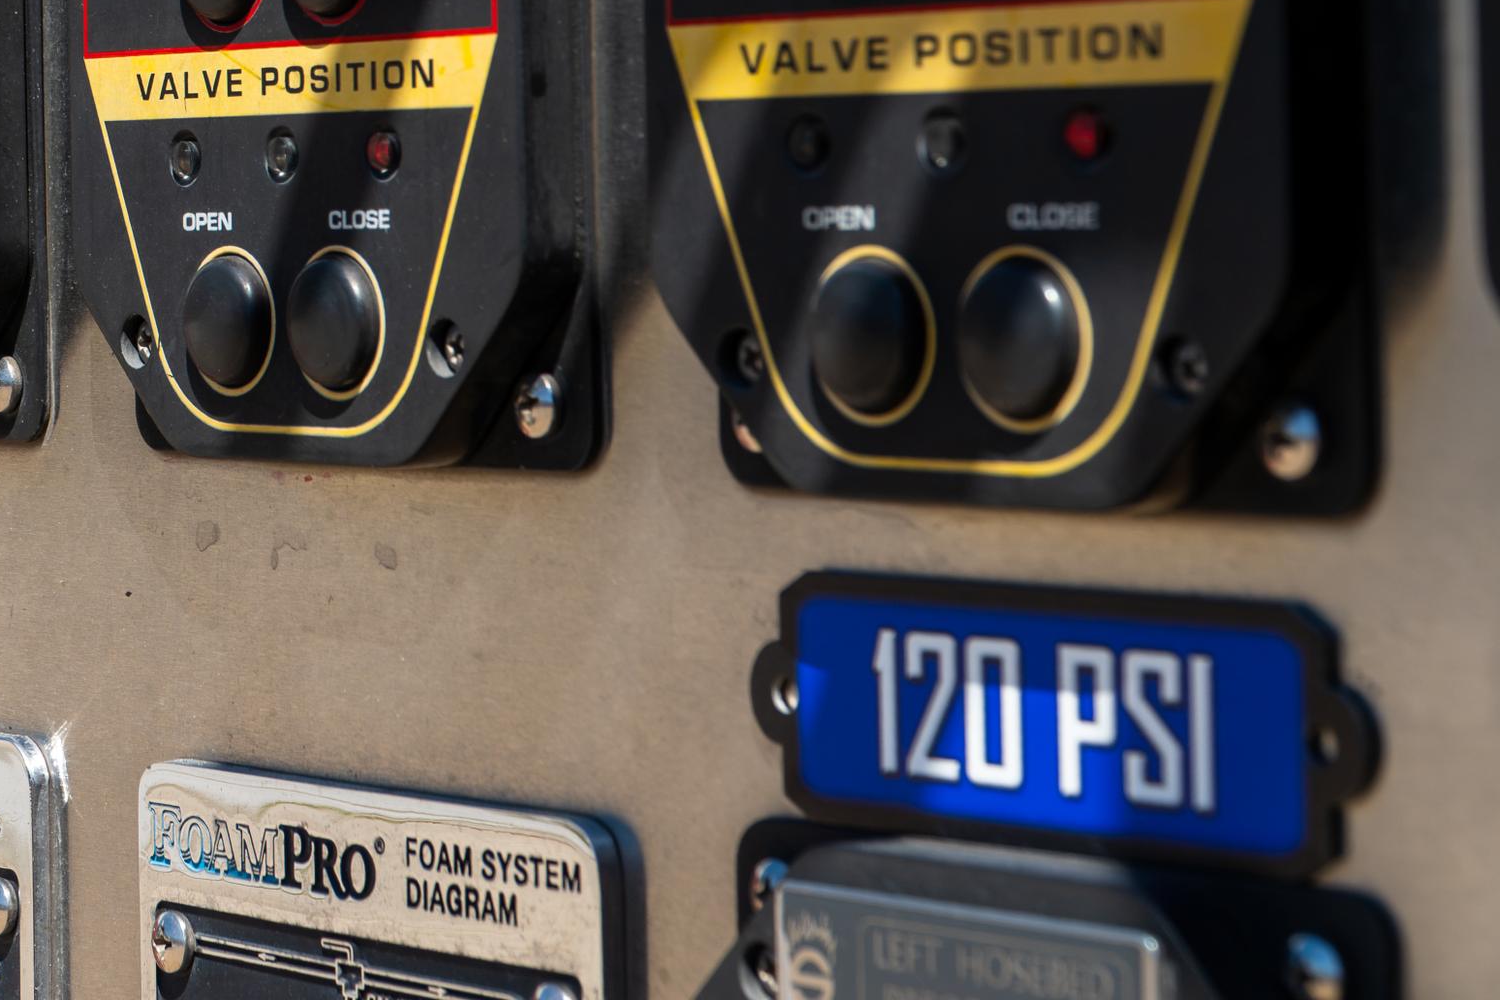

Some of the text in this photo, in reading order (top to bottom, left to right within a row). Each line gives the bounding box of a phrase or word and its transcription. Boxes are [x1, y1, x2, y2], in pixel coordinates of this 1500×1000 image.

[740, 23, 1165, 76] VALVE POSITION
[136, 58, 435, 101] VALVE POSITION
[182, 211, 234, 232] OPEN
[328, 208, 391, 231] CLOSE
[803, 204, 876, 231] OPEN
[1007, 202, 1100, 231] CLOSE
[871, 627, 1216, 813] 120 PSI
[405, 837, 582, 894] FOAM SYSTEM
[406, 877, 519, 927] DIAGRAM
[872, 929, 943, 972] LEFT
